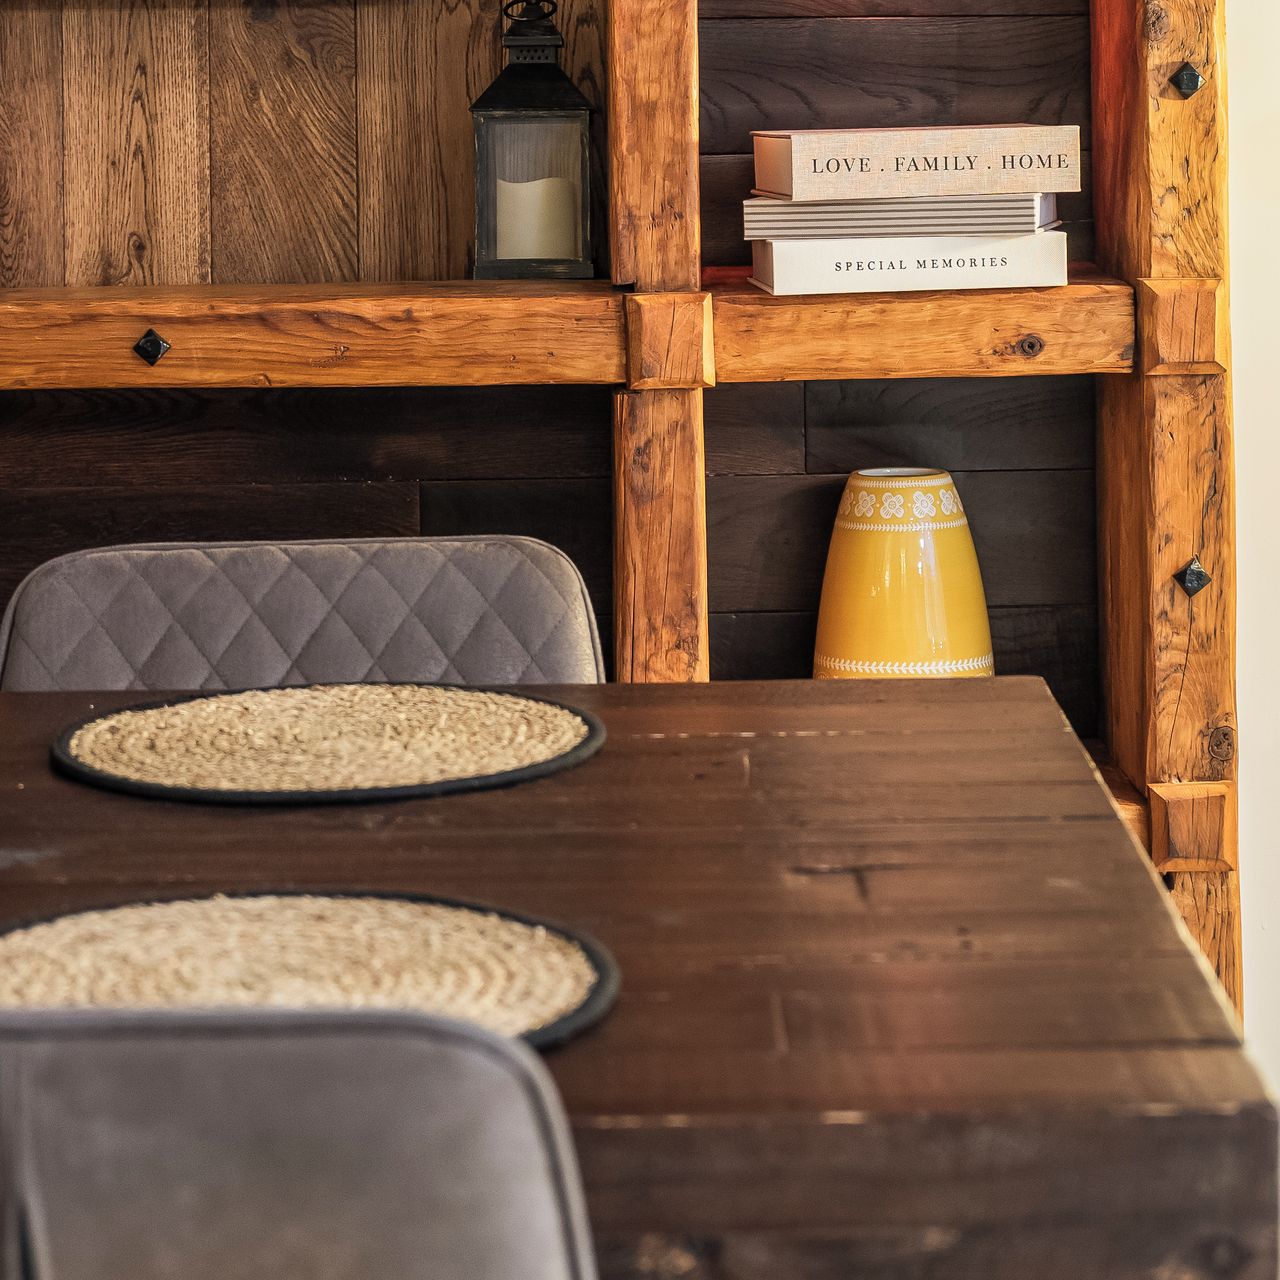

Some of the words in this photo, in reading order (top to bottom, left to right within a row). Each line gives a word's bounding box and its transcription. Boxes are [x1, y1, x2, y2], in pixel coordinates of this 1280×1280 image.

[811, 157, 872, 174] LOVE
[894, 155, 979, 172] FAMILY
[1001, 153, 1070, 170] HOME
[834, 259, 908, 272] SPECIAL
[916, 256, 1008, 269] MEMORIES
